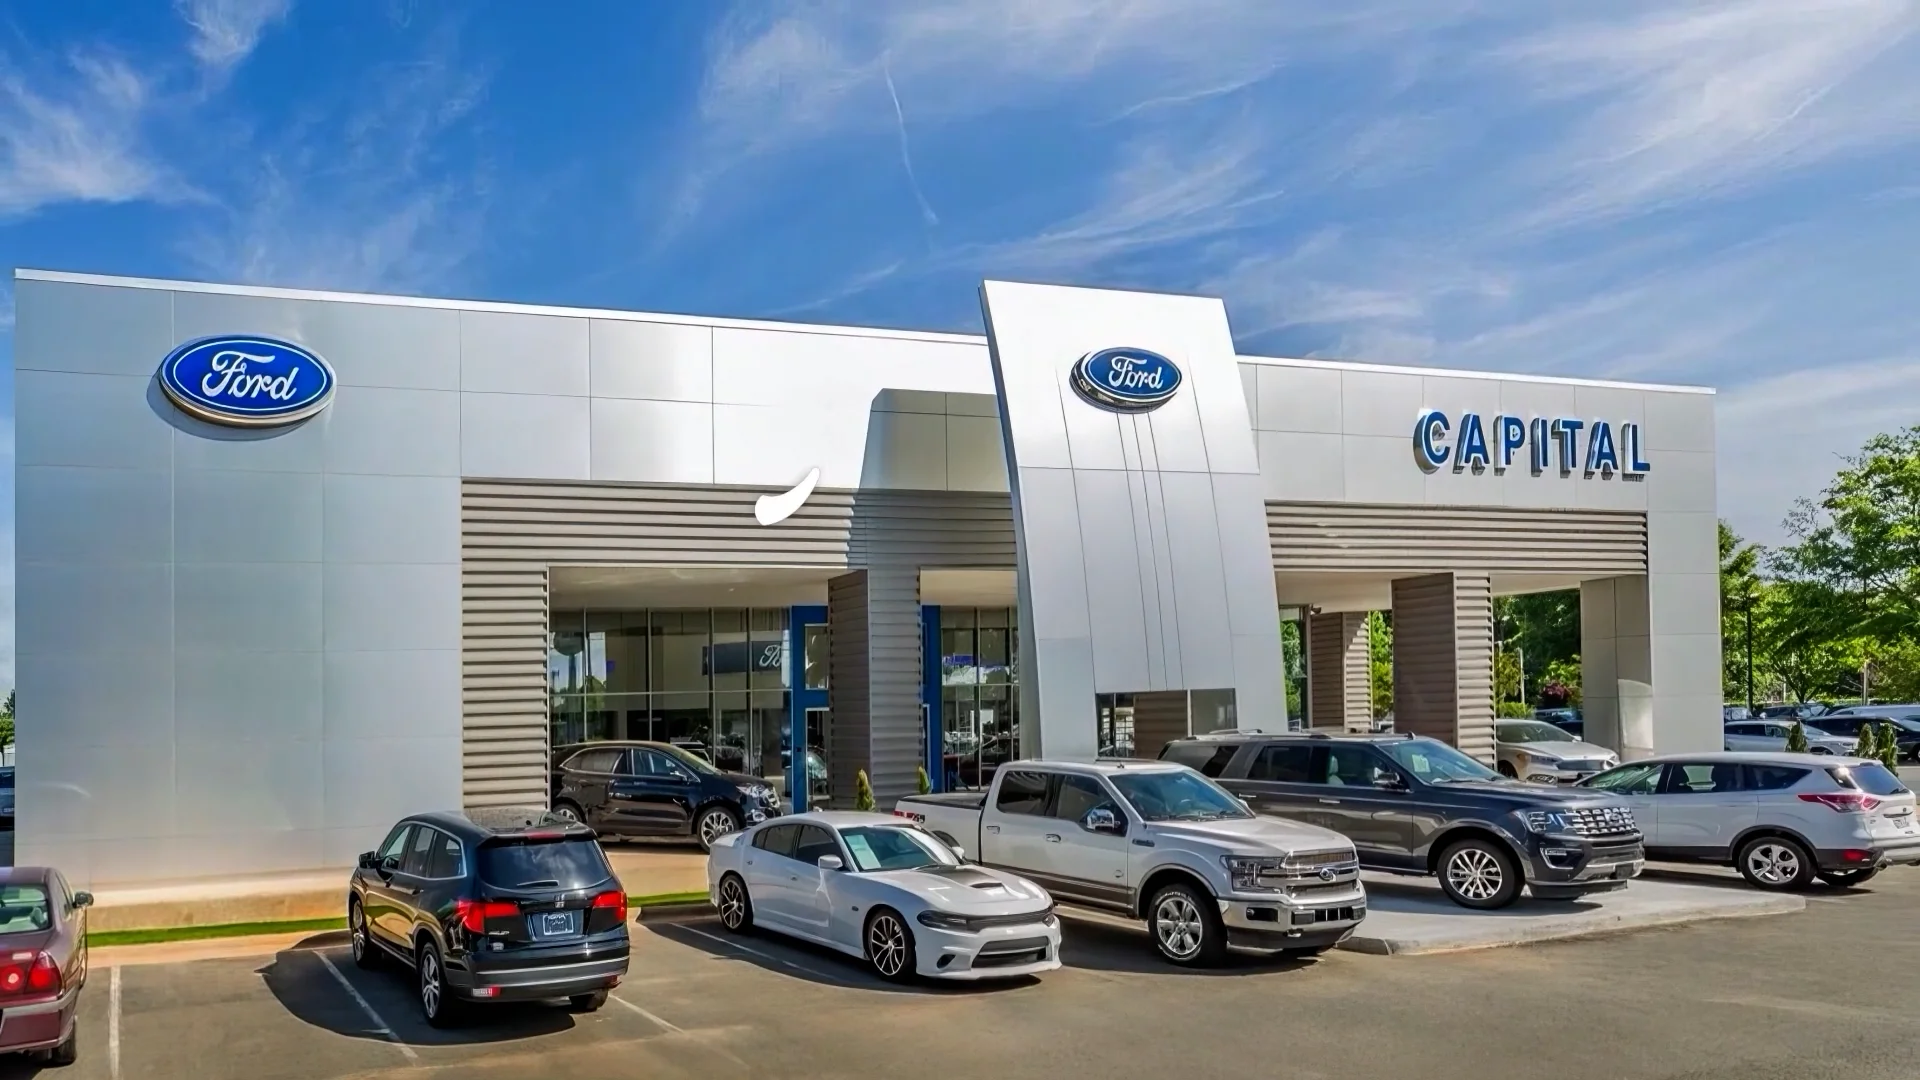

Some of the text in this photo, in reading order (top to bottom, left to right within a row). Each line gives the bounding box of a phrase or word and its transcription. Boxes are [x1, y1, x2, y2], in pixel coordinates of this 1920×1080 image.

[202, 350, 299, 400] Ford
[1108, 356, 1164, 389] Ford
[1414, 410, 1651, 479] CAPITAL
